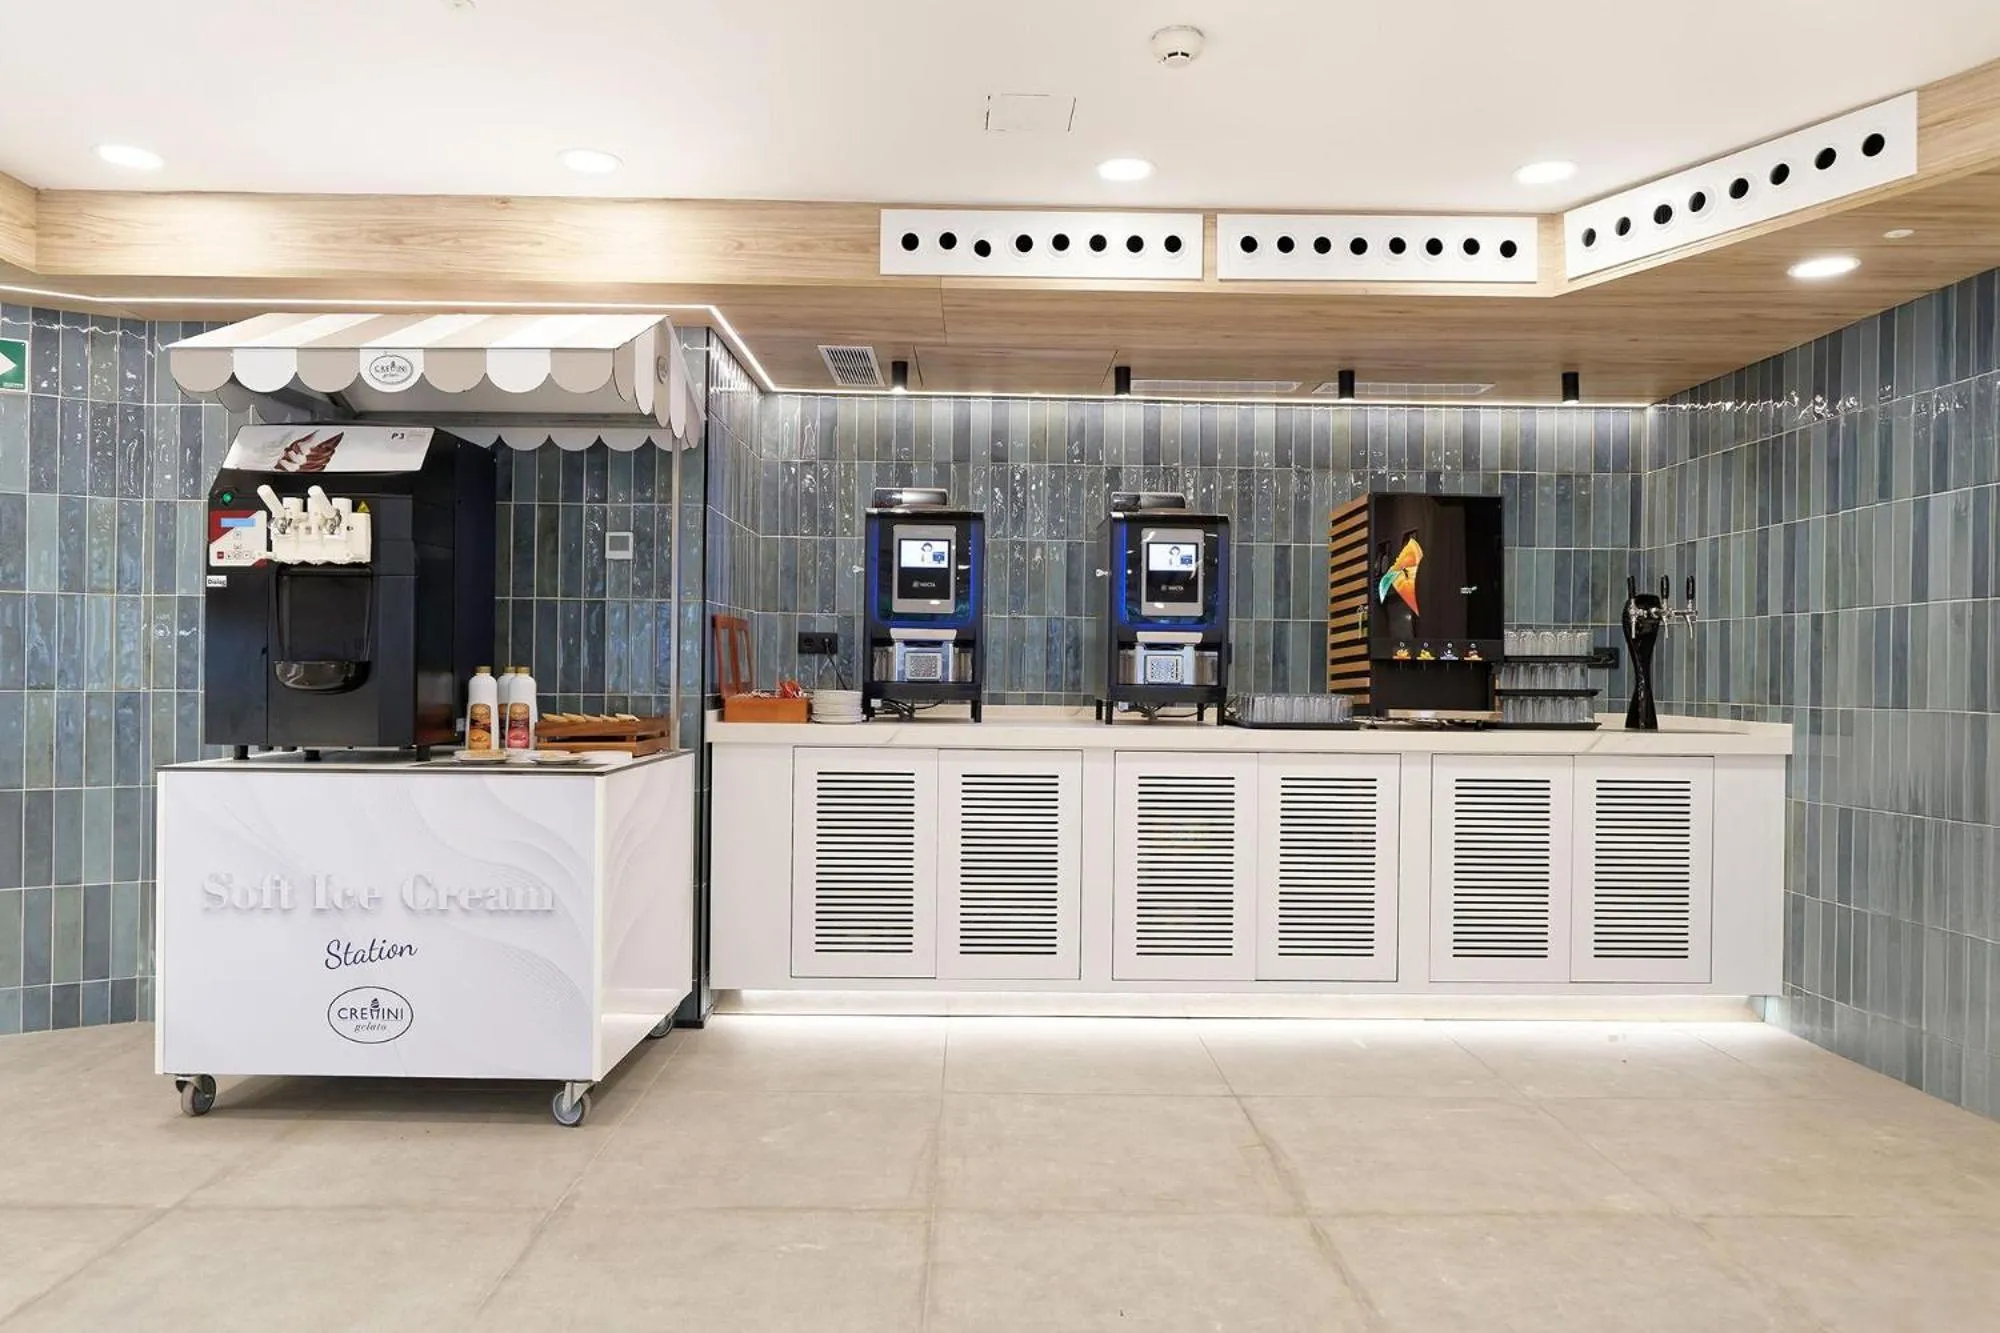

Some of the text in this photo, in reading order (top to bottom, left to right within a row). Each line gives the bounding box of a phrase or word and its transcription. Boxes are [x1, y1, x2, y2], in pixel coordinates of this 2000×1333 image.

[202, 871, 557, 913] Soft Ice Cream
[325, 938, 418, 970] Station
[354, 1021, 387, 1033] gelato
